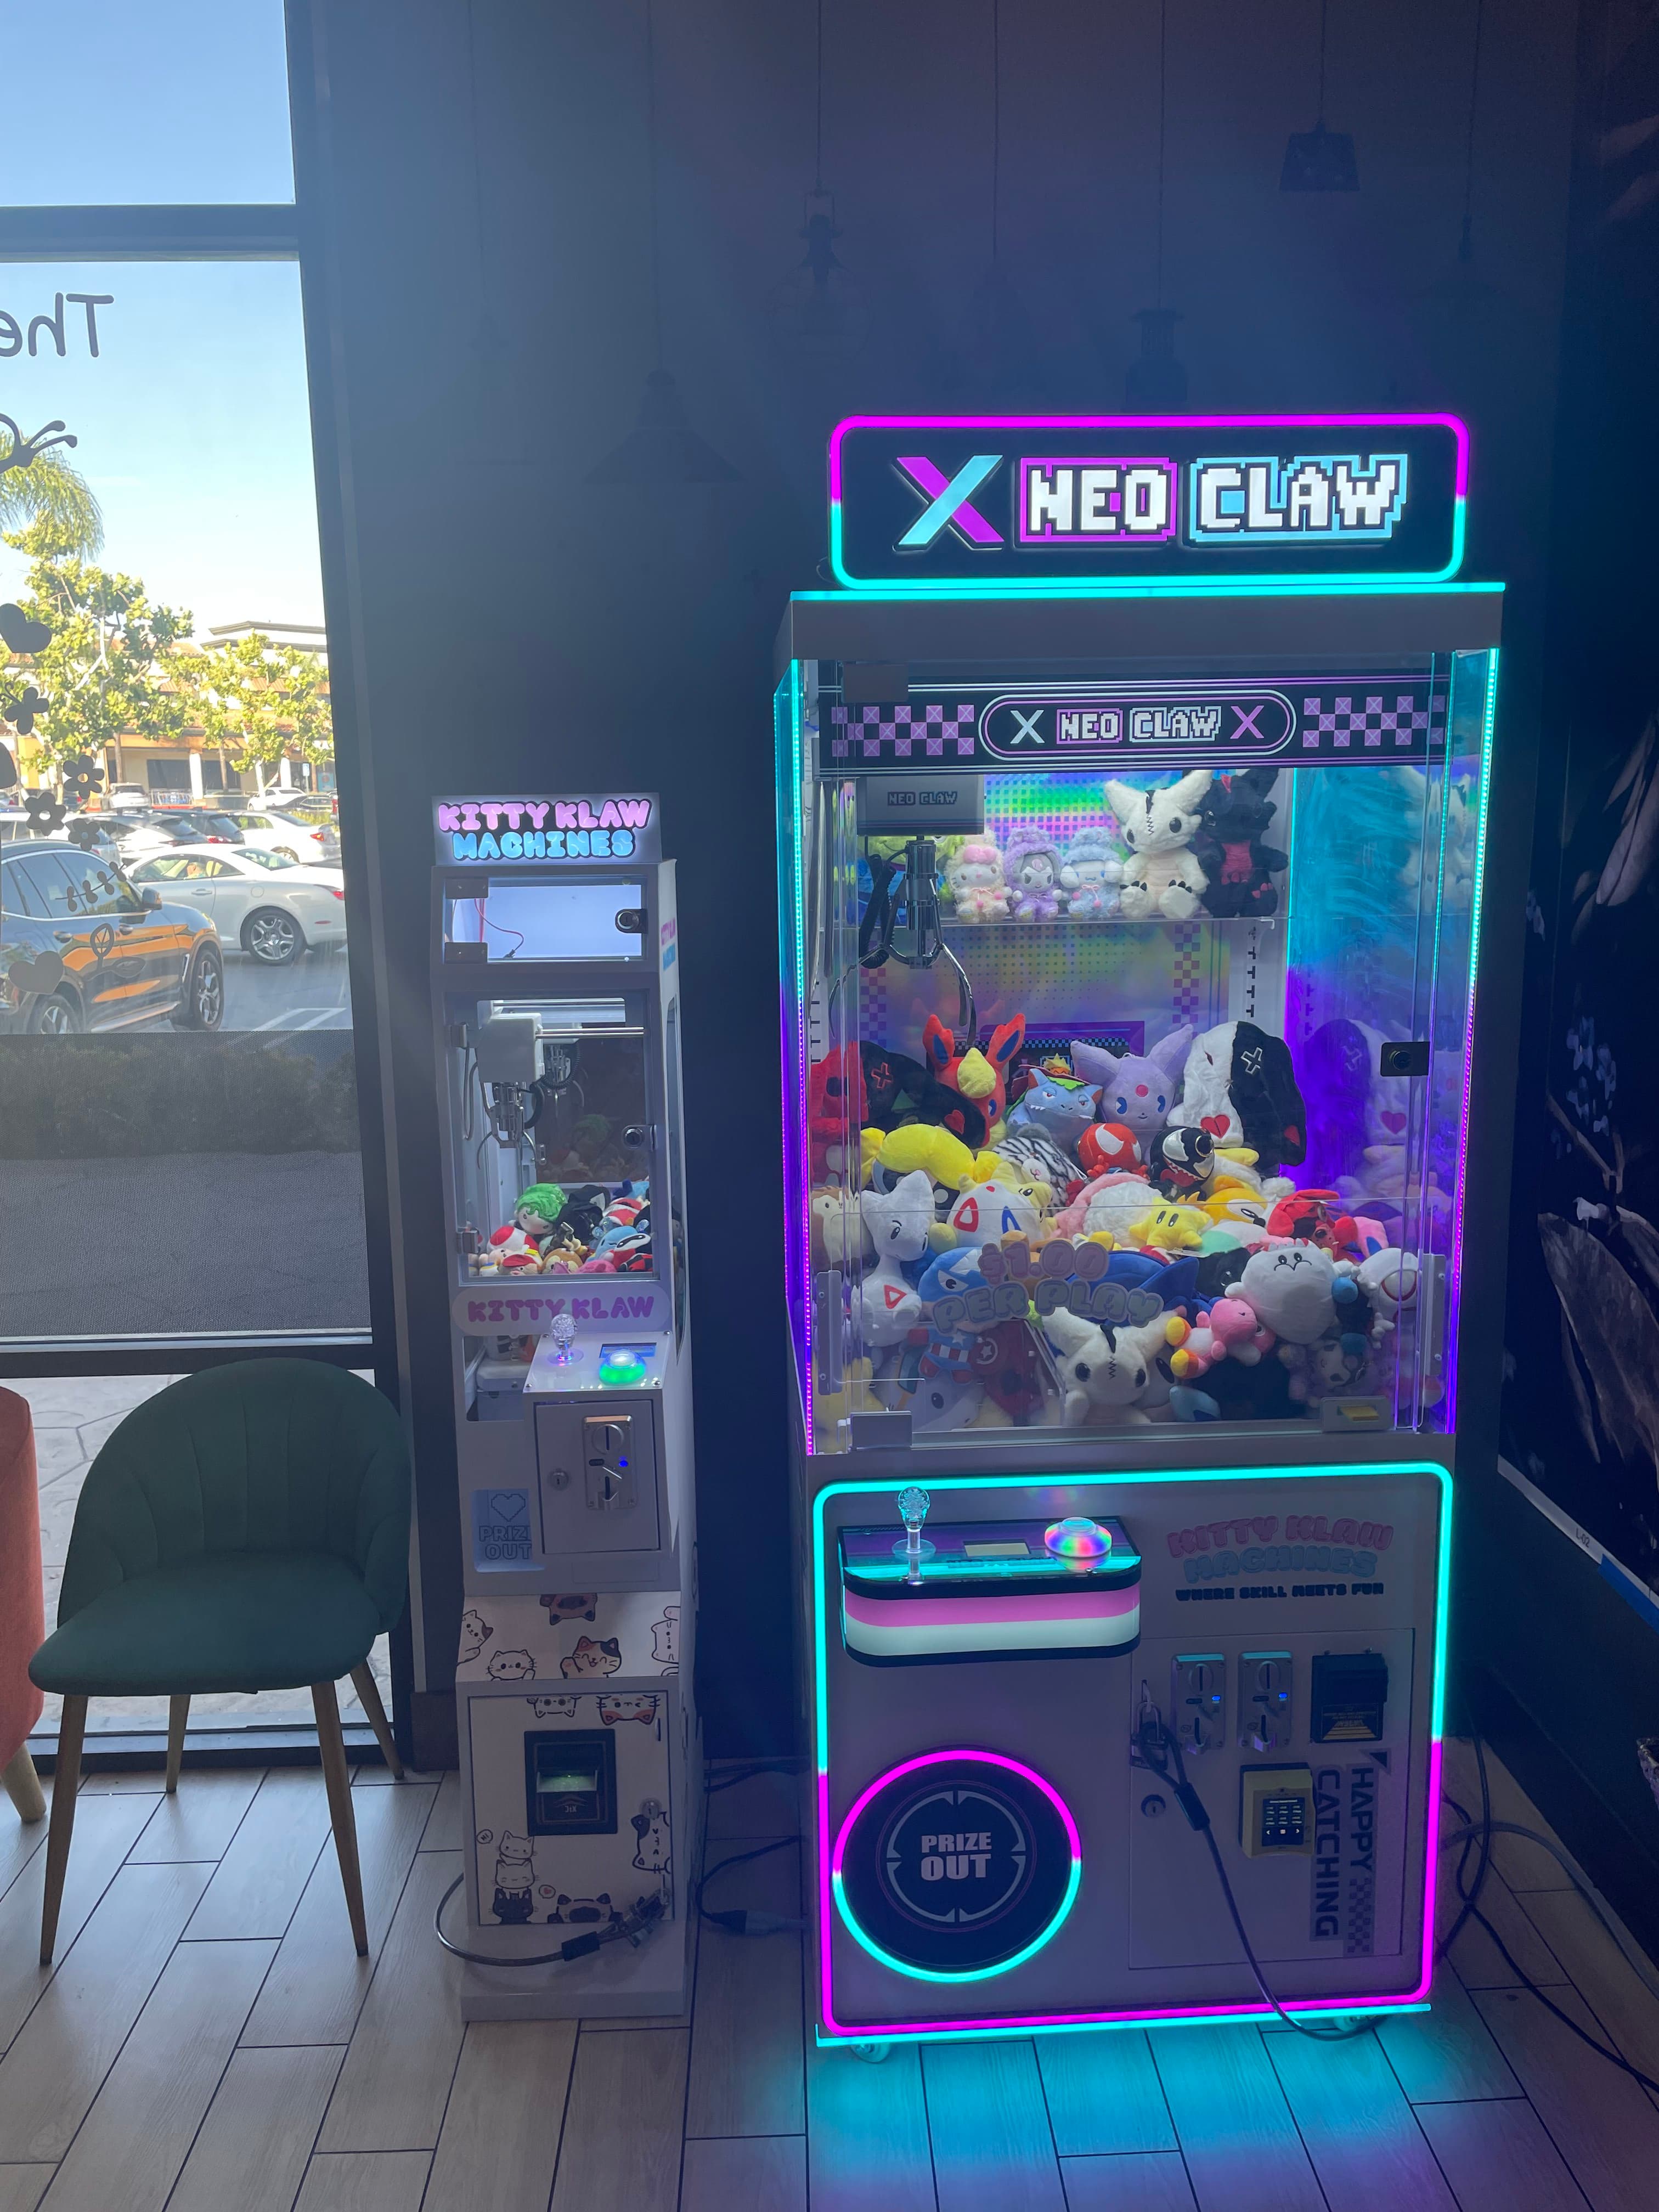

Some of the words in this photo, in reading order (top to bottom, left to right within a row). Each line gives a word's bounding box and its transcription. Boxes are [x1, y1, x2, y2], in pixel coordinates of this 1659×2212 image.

[1029, 467, 1169, 532] NEO
[1199, 464, 1398, 529] CLAW
[1060, 712, 1119, 740] NEO
[1133, 710, 1220, 738] CLAW
[889, 793, 915, 805] NEO
[920, 792, 957, 804] CLAW
[438, 801, 550, 832] KITTY
[555, 799, 651, 829] KLAW
[452, 828, 634, 859] MACHINES
[979, 1240, 1108, 1285] $1.00
[468, 1299, 565, 1322] KITTY
[572, 1296, 654, 1321] KLAW
[933, 1282, 1029, 1335] PER
[1036, 1280, 1162, 1327] PLAY
[485, 1543, 532, 1560] OUT
[1167, 1515, 1279, 1558] KITTY
[1286, 1515, 1394, 1551] KLAW
[1183, 1545, 1378, 1584] MACHINES
[1175, 1588, 1235, 1601] WHERE
[1239, 1586, 1287, 1599] SKILL
[1291, 1583, 1347, 1597] MEETS
[1351, 1583, 1384, 1595] FUN
[1350, 1768, 1374, 1872] HAPPY
[921, 1831, 992, 1853] PRIZE
[1316, 1769, 1340, 1937] CATCHING
[921, 1854, 992, 1881] OUT
